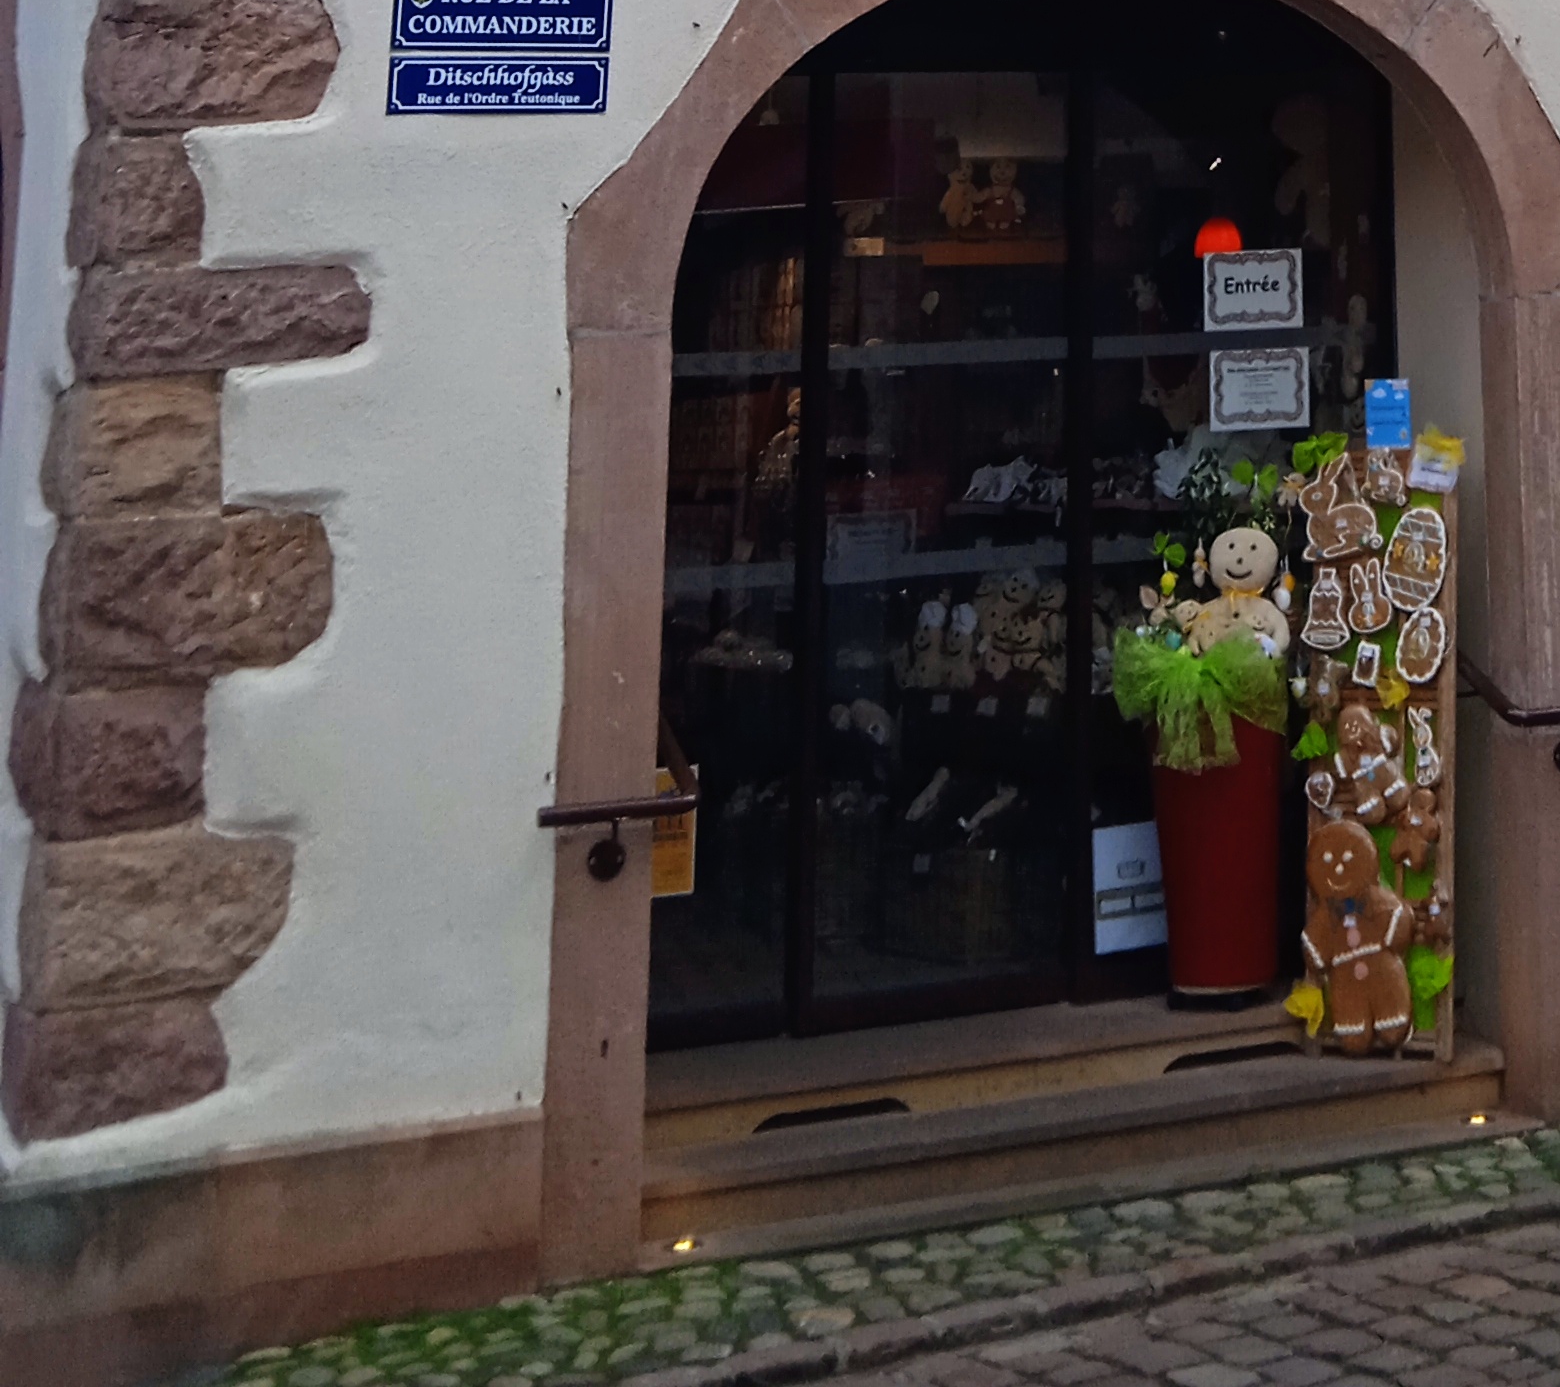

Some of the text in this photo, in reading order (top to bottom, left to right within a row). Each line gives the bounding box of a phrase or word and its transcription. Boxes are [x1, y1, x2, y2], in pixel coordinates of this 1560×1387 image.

[408, 15, 596, 35] COMMANDERIE
[426, 65, 575, 93] Ditschhofgàss
[417, 92, 580, 107] Rue de l'Ordre Teutonique
[1224, 274, 1280, 295] Entrée
